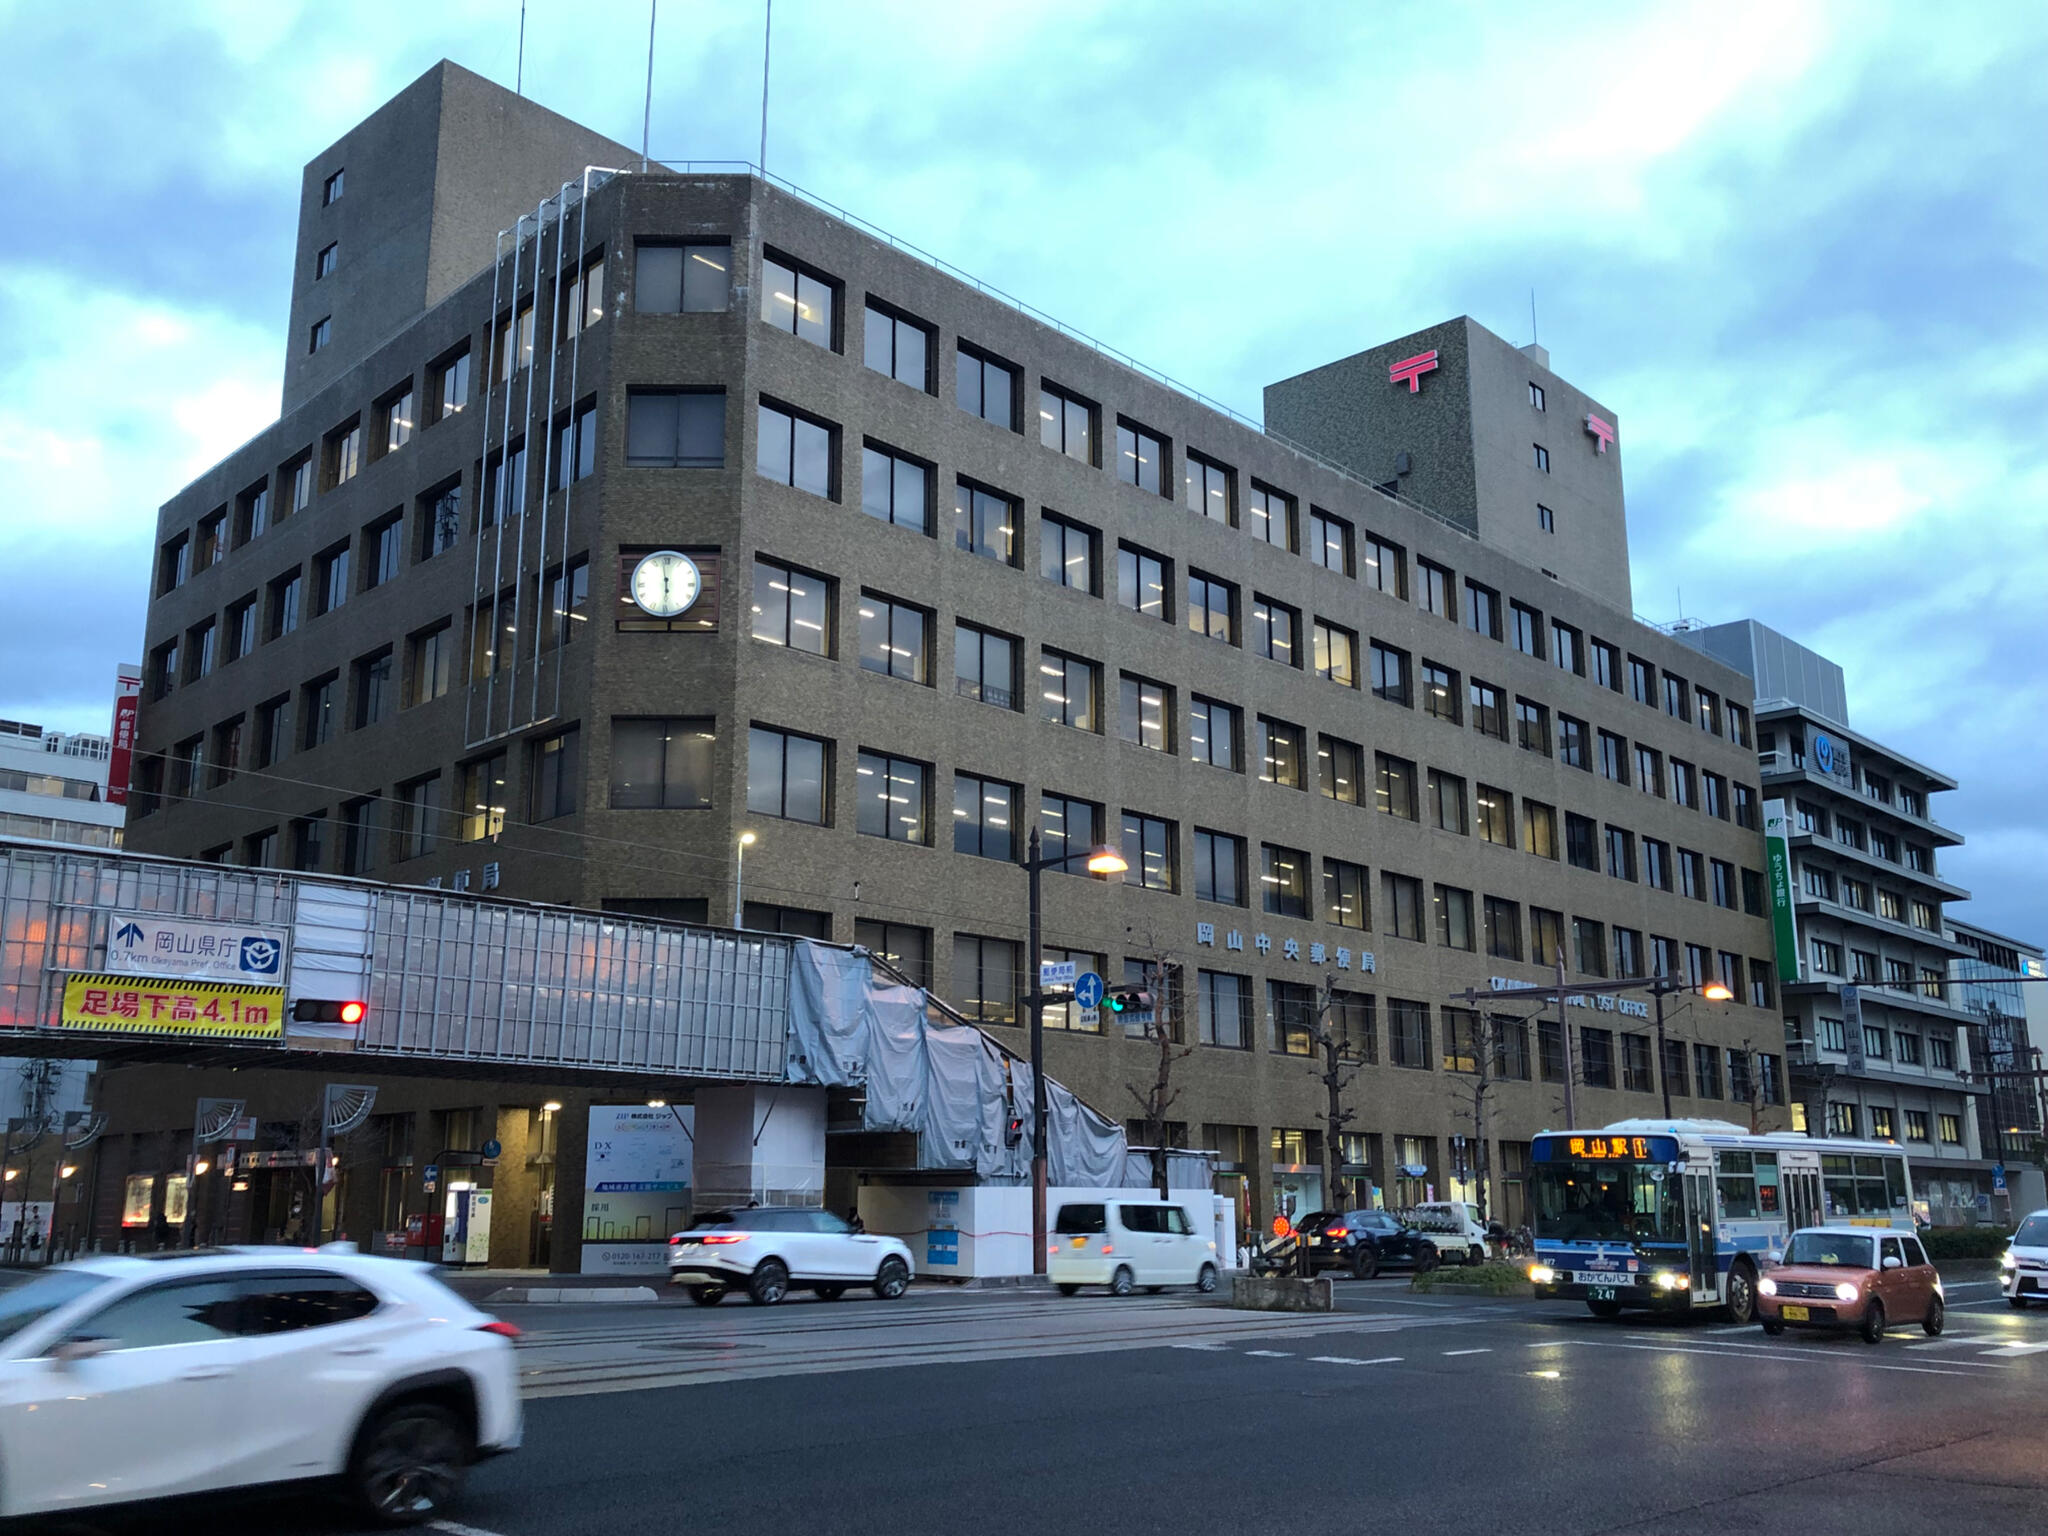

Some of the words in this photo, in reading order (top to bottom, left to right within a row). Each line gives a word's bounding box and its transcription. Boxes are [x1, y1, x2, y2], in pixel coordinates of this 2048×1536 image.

[118, 720, 130, 749] 郵便局
[1773, 854, 1786, 908] ゆうちょ銀行
[154, 930, 238, 958] 岡山県庁
[1197, 921, 1376, 974] 岡山中央郵便局
[110, 950, 148, 964] 0.7km
[151, 956, 189, 968] Okayama
[81, 989, 269, 1024] 足場下高4.1m
[1619, 999, 1648, 1017] OFFICE
[1570, 1138, 1628, 1154] 岡山駅
